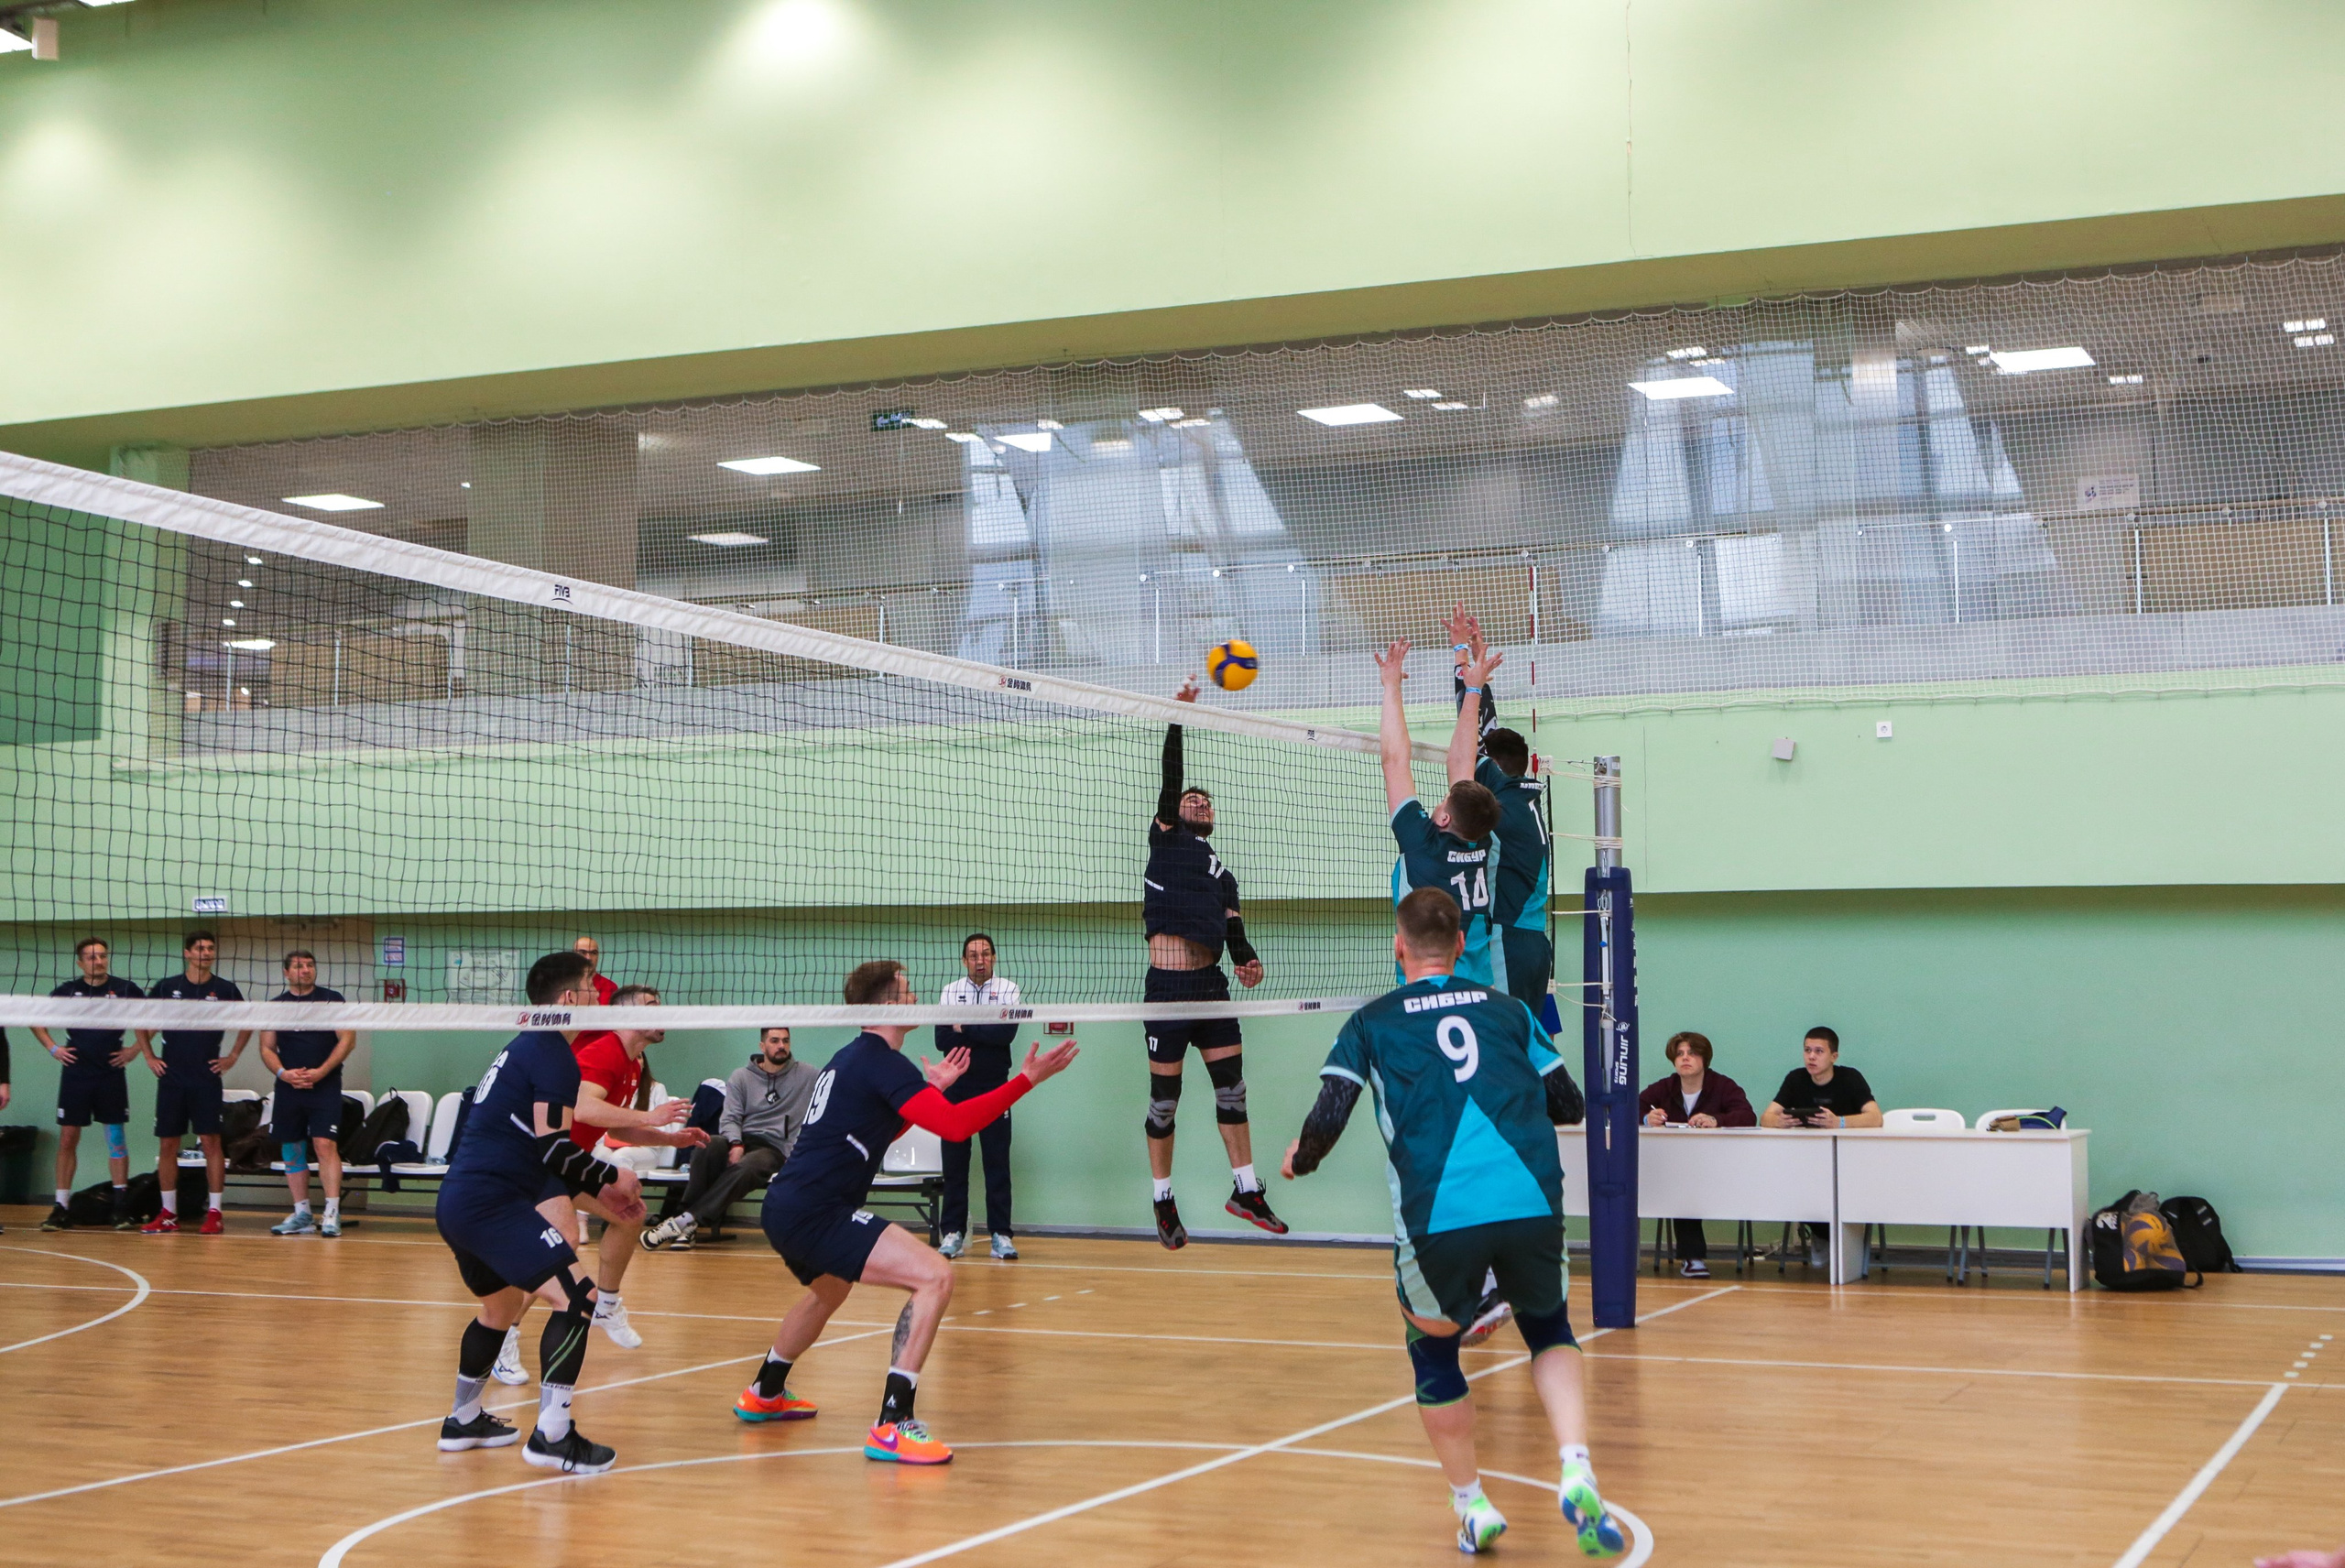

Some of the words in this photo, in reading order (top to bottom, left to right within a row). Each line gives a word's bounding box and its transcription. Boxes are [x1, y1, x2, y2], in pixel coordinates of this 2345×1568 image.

[1447, 849, 1487, 863] СИБУР
[1451, 867, 1489, 911] 14
[1403, 990, 1489, 1014] СИБУР
[1148, 1036, 1159, 1052] 17
[1436, 1015, 1479, 1083] 9
[1619, 1034, 1629, 1085] JINLING
[540, 1227, 564, 1248] 16
